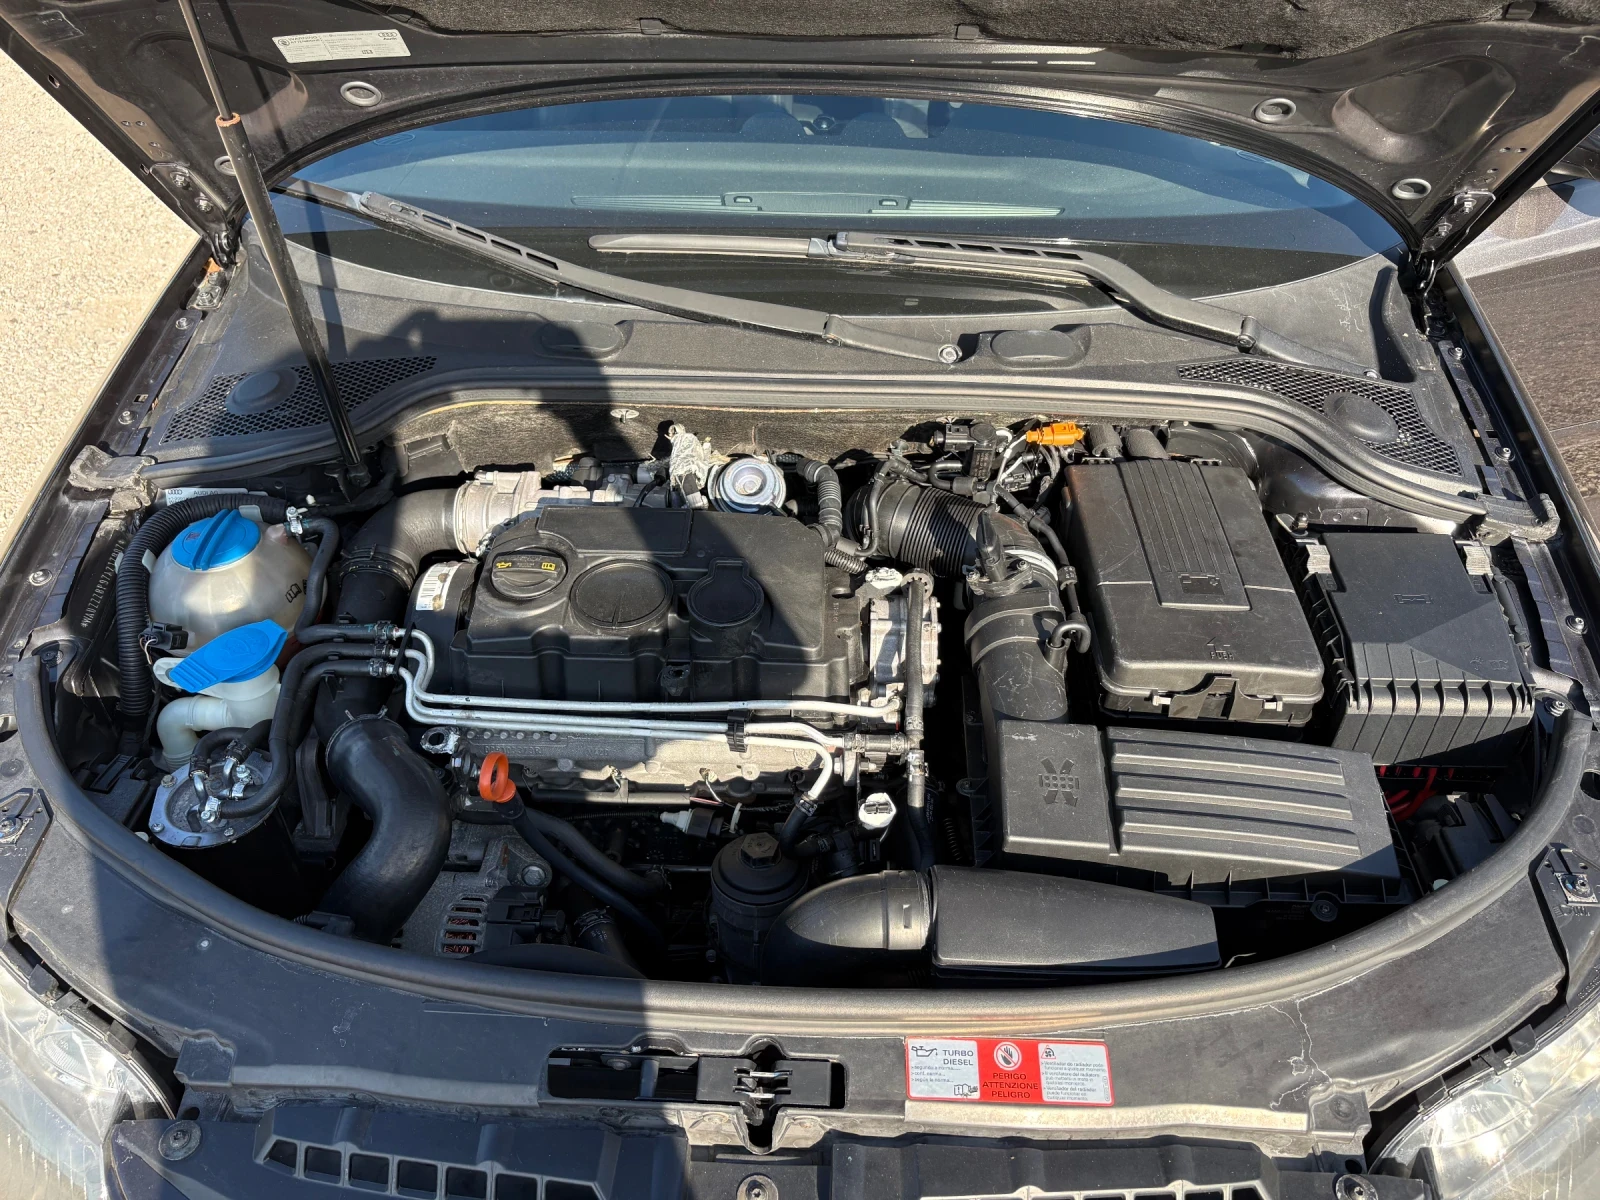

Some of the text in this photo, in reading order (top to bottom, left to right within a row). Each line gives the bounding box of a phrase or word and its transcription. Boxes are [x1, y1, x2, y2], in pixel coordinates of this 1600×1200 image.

[942, 1049, 974, 1057] TURBO
[942, 1058, 974, 1066] DIESEL
[992, 1072, 1027, 1080] PERIGO
[982, 1081, 1039, 1090] ATTENZIONE
[991, 1090, 1031, 1099] PELIGRO
